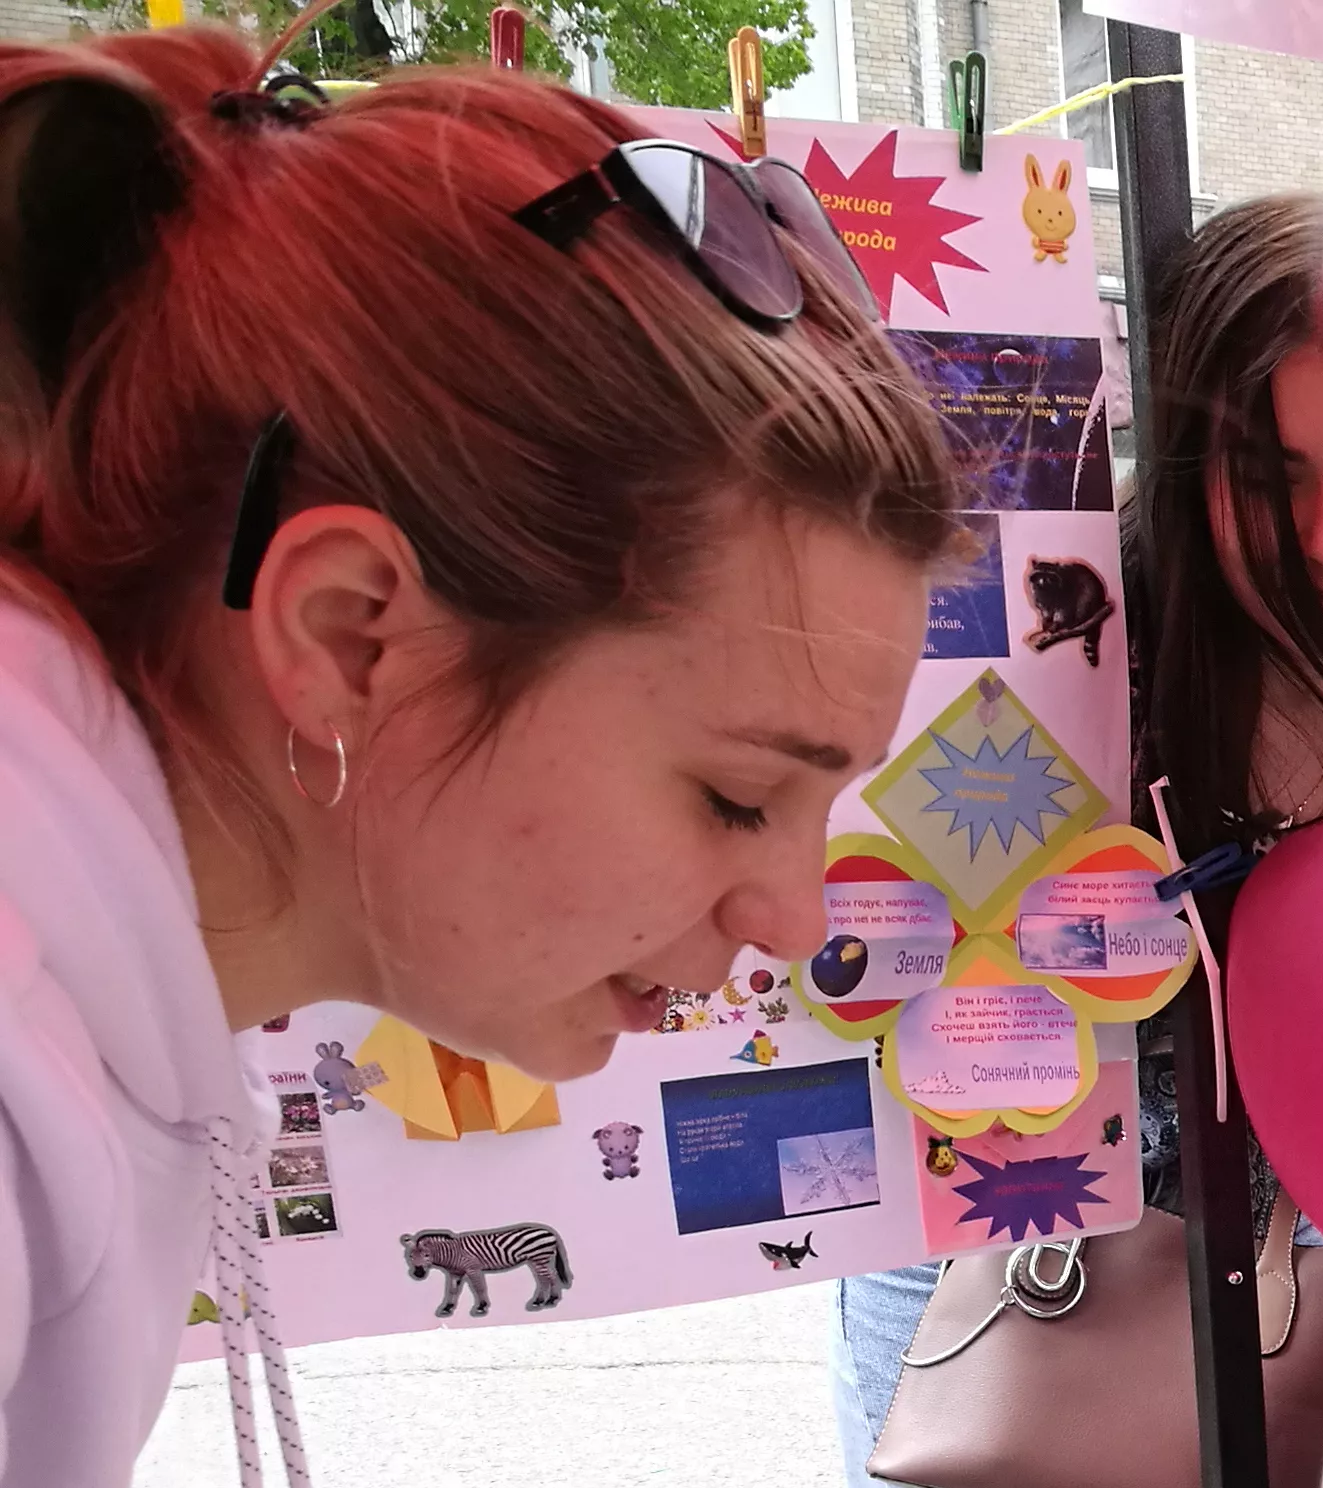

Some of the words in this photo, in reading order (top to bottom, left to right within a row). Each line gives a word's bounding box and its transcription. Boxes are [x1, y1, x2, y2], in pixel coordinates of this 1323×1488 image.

[815, 188, 893, 216] ежива
[839, 228, 897, 251] рода
[1081, 881, 1109, 892] море
[830, 898, 852, 909] Всіх
[833, 916, 852, 927] про
[1108, 931, 1141, 957] Небо
[1150, 936, 1188, 963] сонце
[894, 949, 945, 975] Земля
[955, 996, 974, 1006] Він
[955, 1010, 968, 1018] як
[931, 1022, 975, 1032] Схочеш
[978, 1020, 1010, 1031] взять
[1013, 1019, 1039, 1030] його
[953, 1033, 995, 1045] мерщій
[971, 1061, 1031, 1084] Сонячний
[1033, 1063, 1081, 1086] промінь
